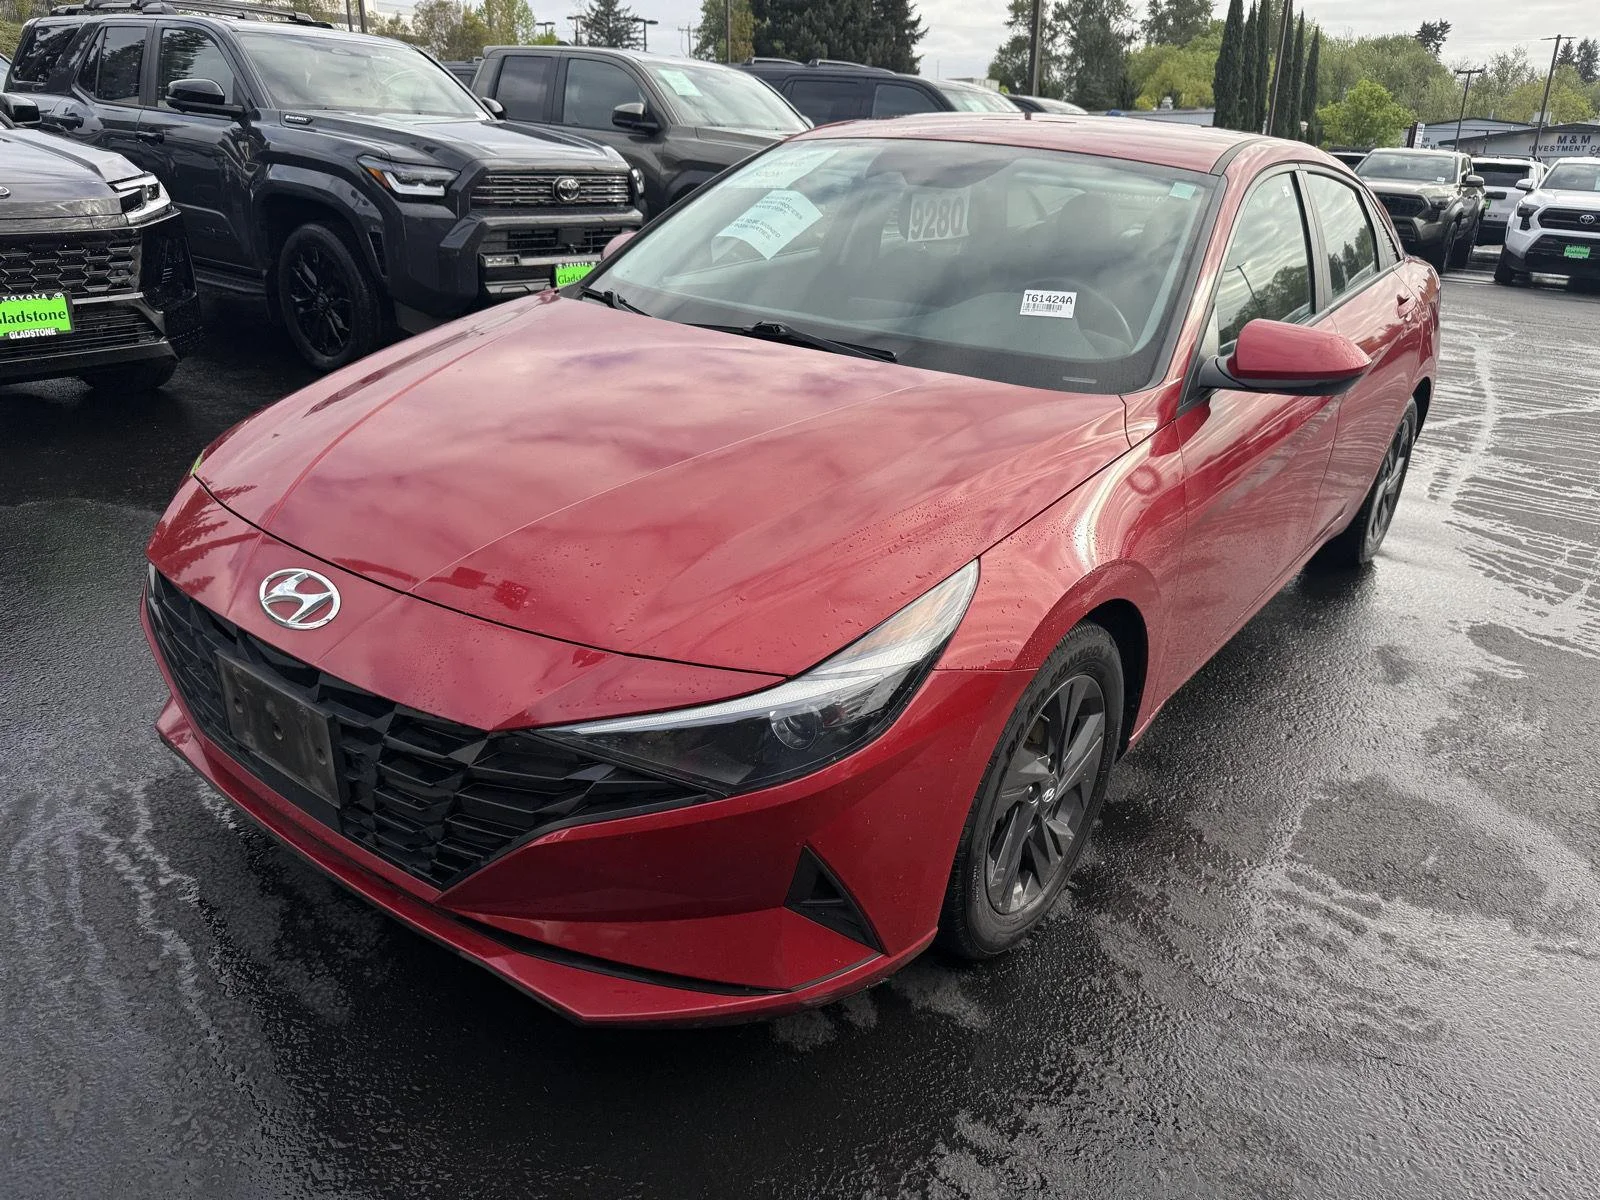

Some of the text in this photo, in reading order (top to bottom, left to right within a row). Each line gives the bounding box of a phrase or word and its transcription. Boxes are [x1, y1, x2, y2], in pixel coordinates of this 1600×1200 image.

[1556, 135, 1568, 145] M
[1580, 135, 1592, 145] M
[910, 197, 965, 240] 9280
[3, 294, 47, 302] TOYOTA
[1025, 293, 1073, 305] T61424A
[9, 328, 56, 339] GLADSTONE
